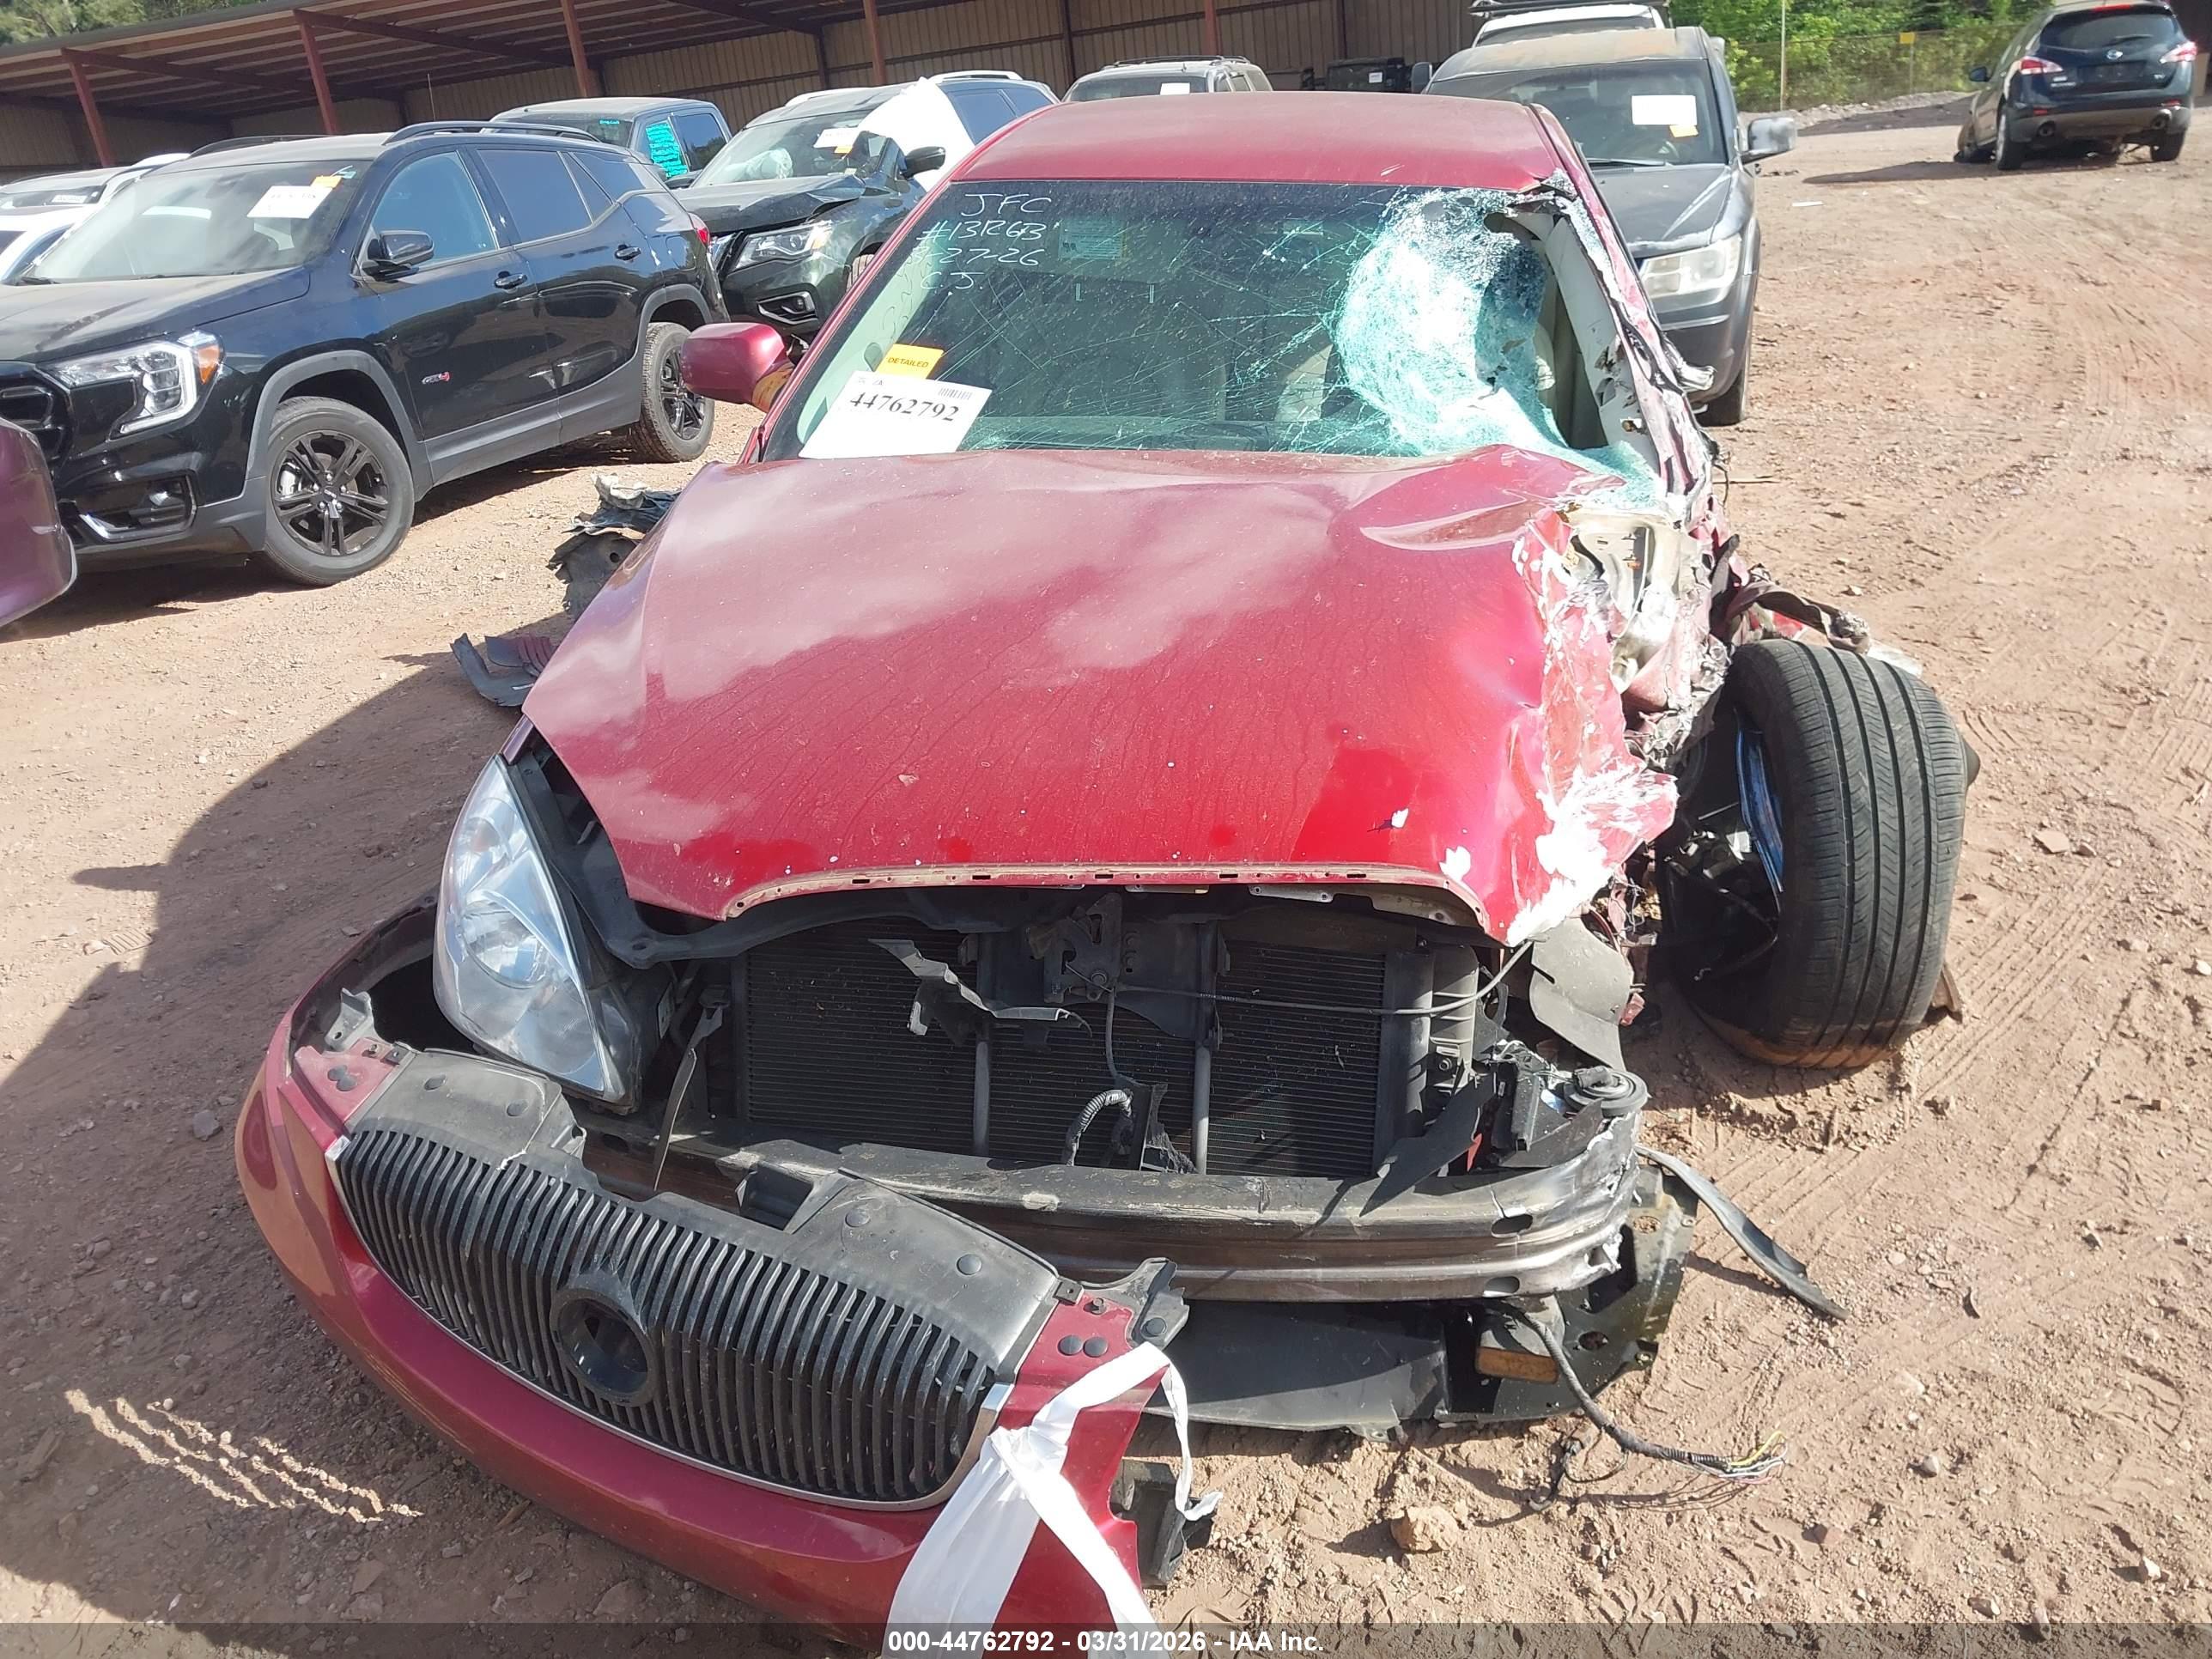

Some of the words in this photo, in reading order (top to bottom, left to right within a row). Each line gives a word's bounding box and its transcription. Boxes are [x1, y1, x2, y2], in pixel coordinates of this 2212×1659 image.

[961, 193, 1052, 216] JFC
[887, 356, 929, 368] DETAILED
[849, 392, 959, 422] 44762792
